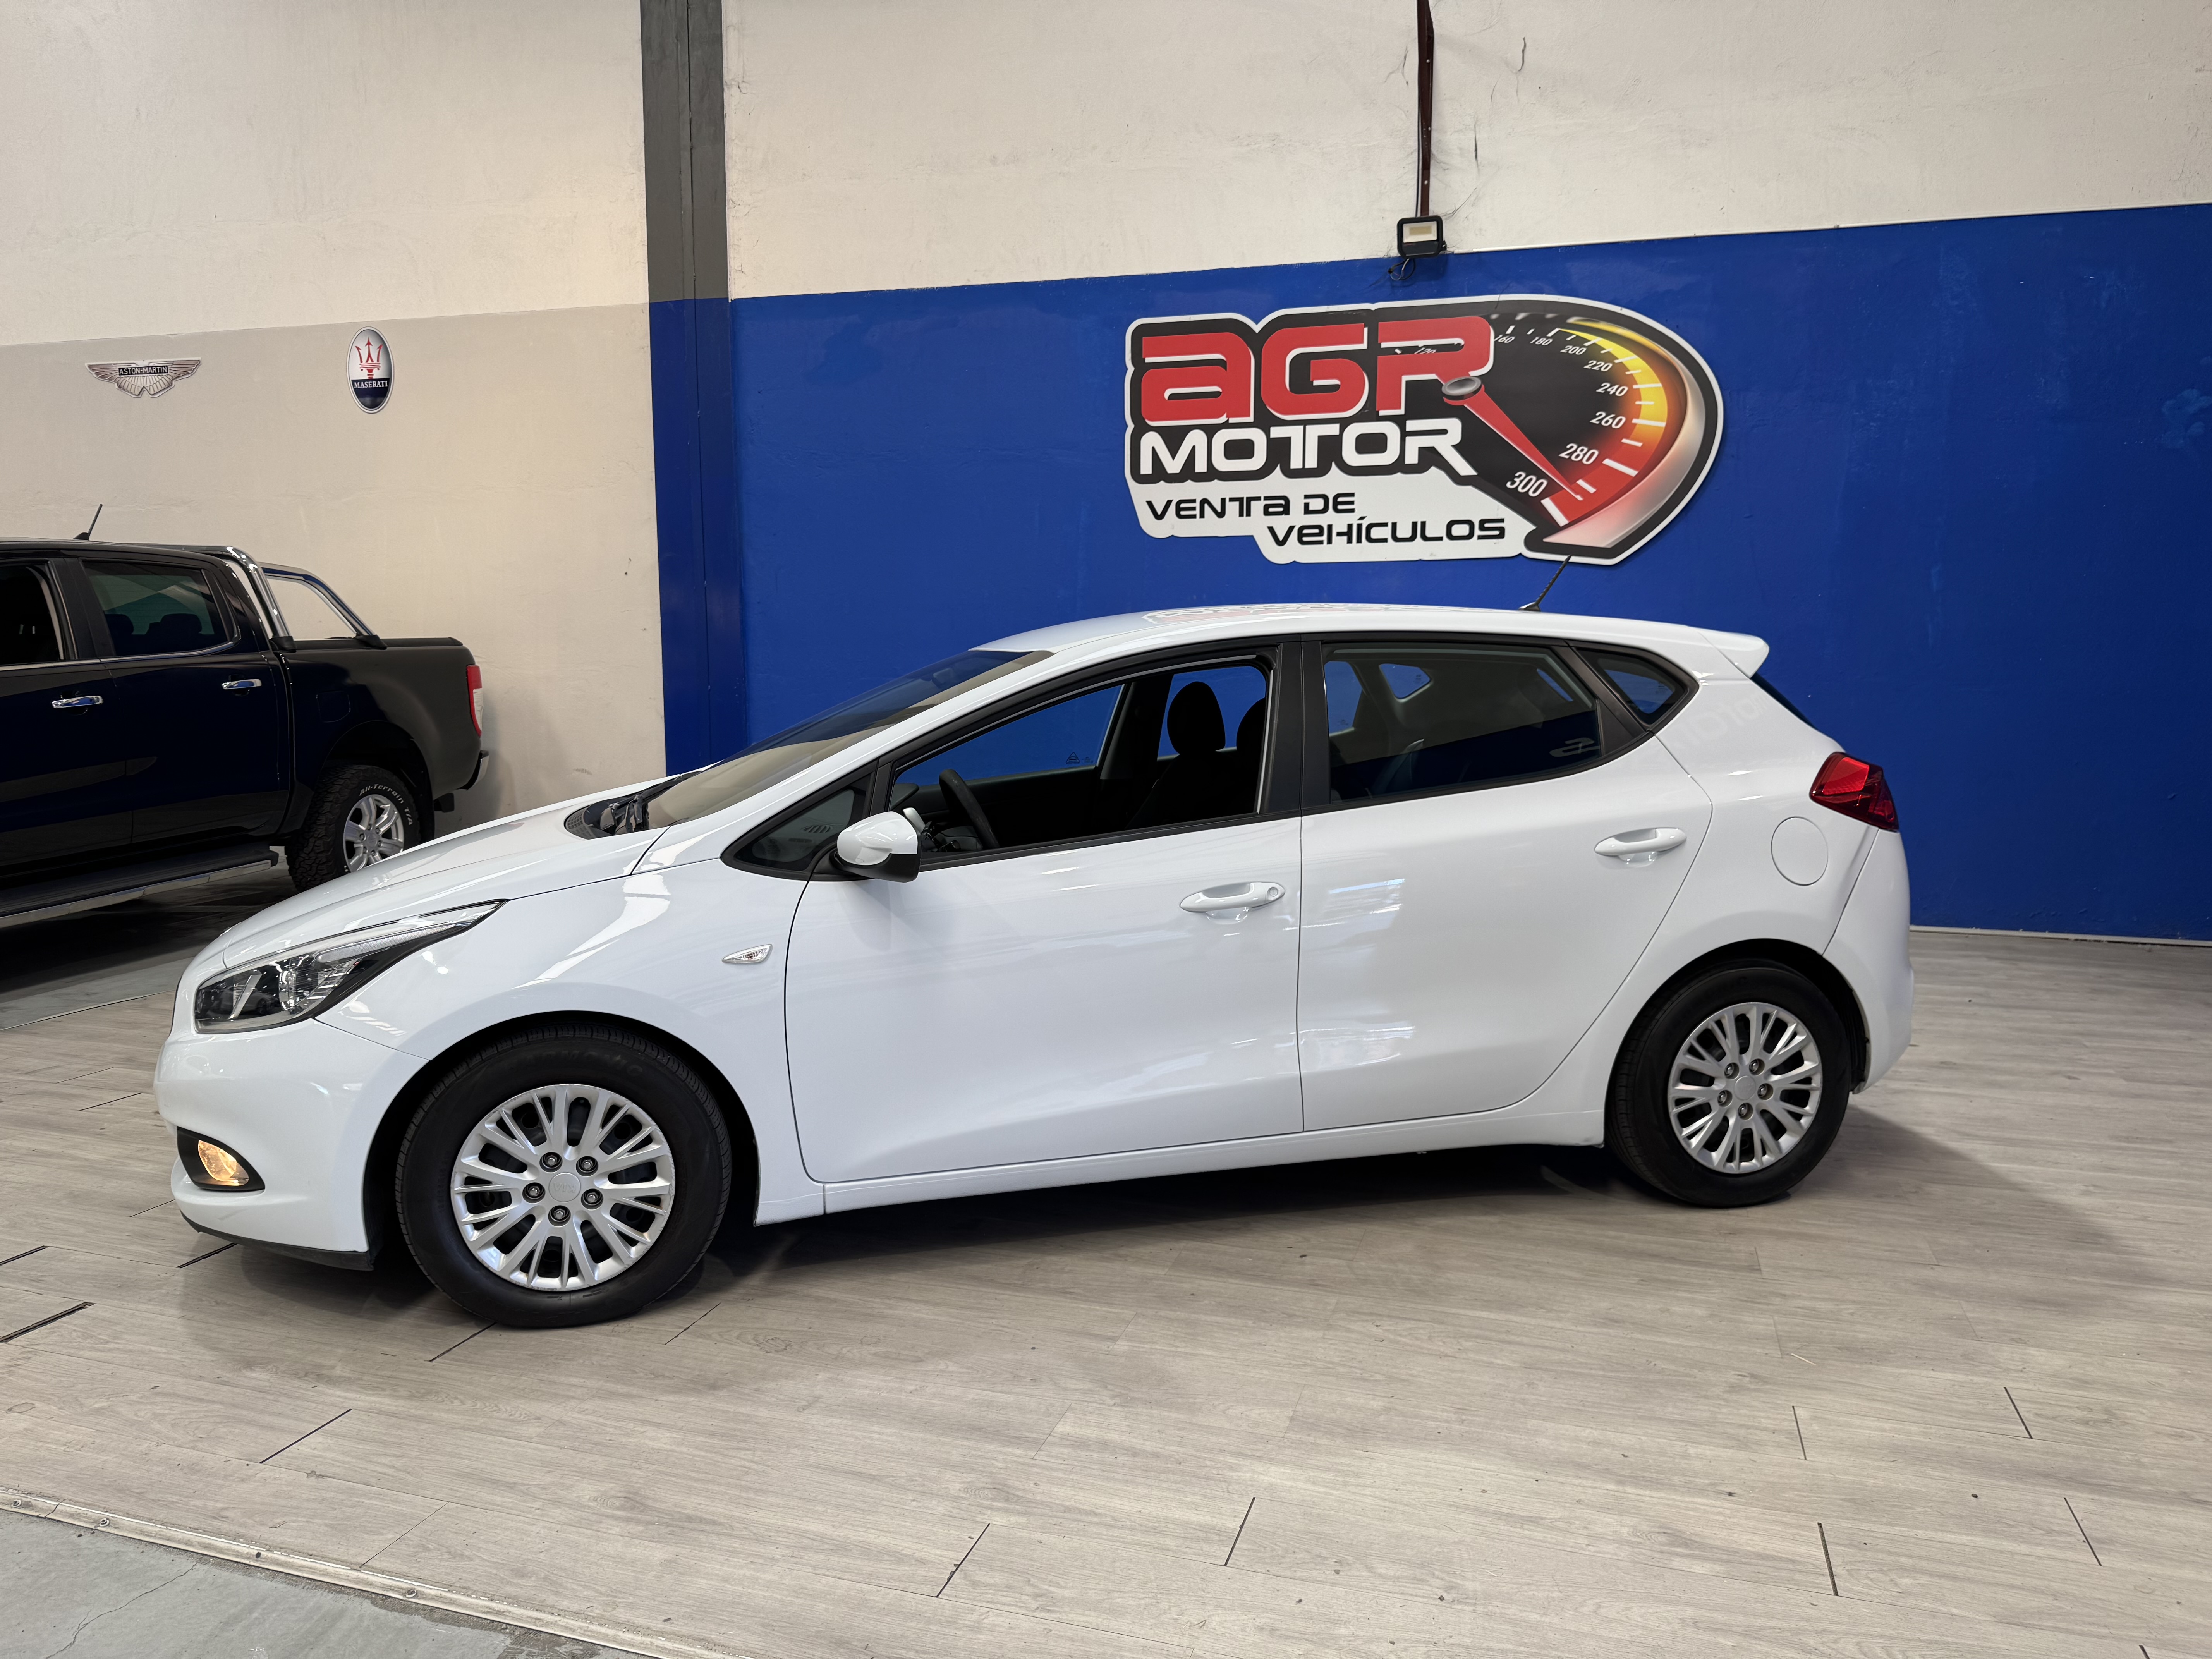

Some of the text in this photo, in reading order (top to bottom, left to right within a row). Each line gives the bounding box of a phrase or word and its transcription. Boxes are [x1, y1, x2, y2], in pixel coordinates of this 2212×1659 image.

[1494, 335, 1515, 343] 160
[1530, 337, 1553, 346] 180
[1560, 345, 1587, 355] 200
[119, 366, 167, 375] ASTON-MARTIN
[1584, 360, 1613, 372] 220
[1596, 382, 1628, 397] 240
[1590, 411, 1626, 429] 260
[1140, 417, 1478, 475] MOTOR
[1559, 443, 1599, 465] 280
[1506, 471, 1547, 497] 300
[1304, 493, 1355, 515] DE
[359, 784, 413, 825] All-Terrain T/A
